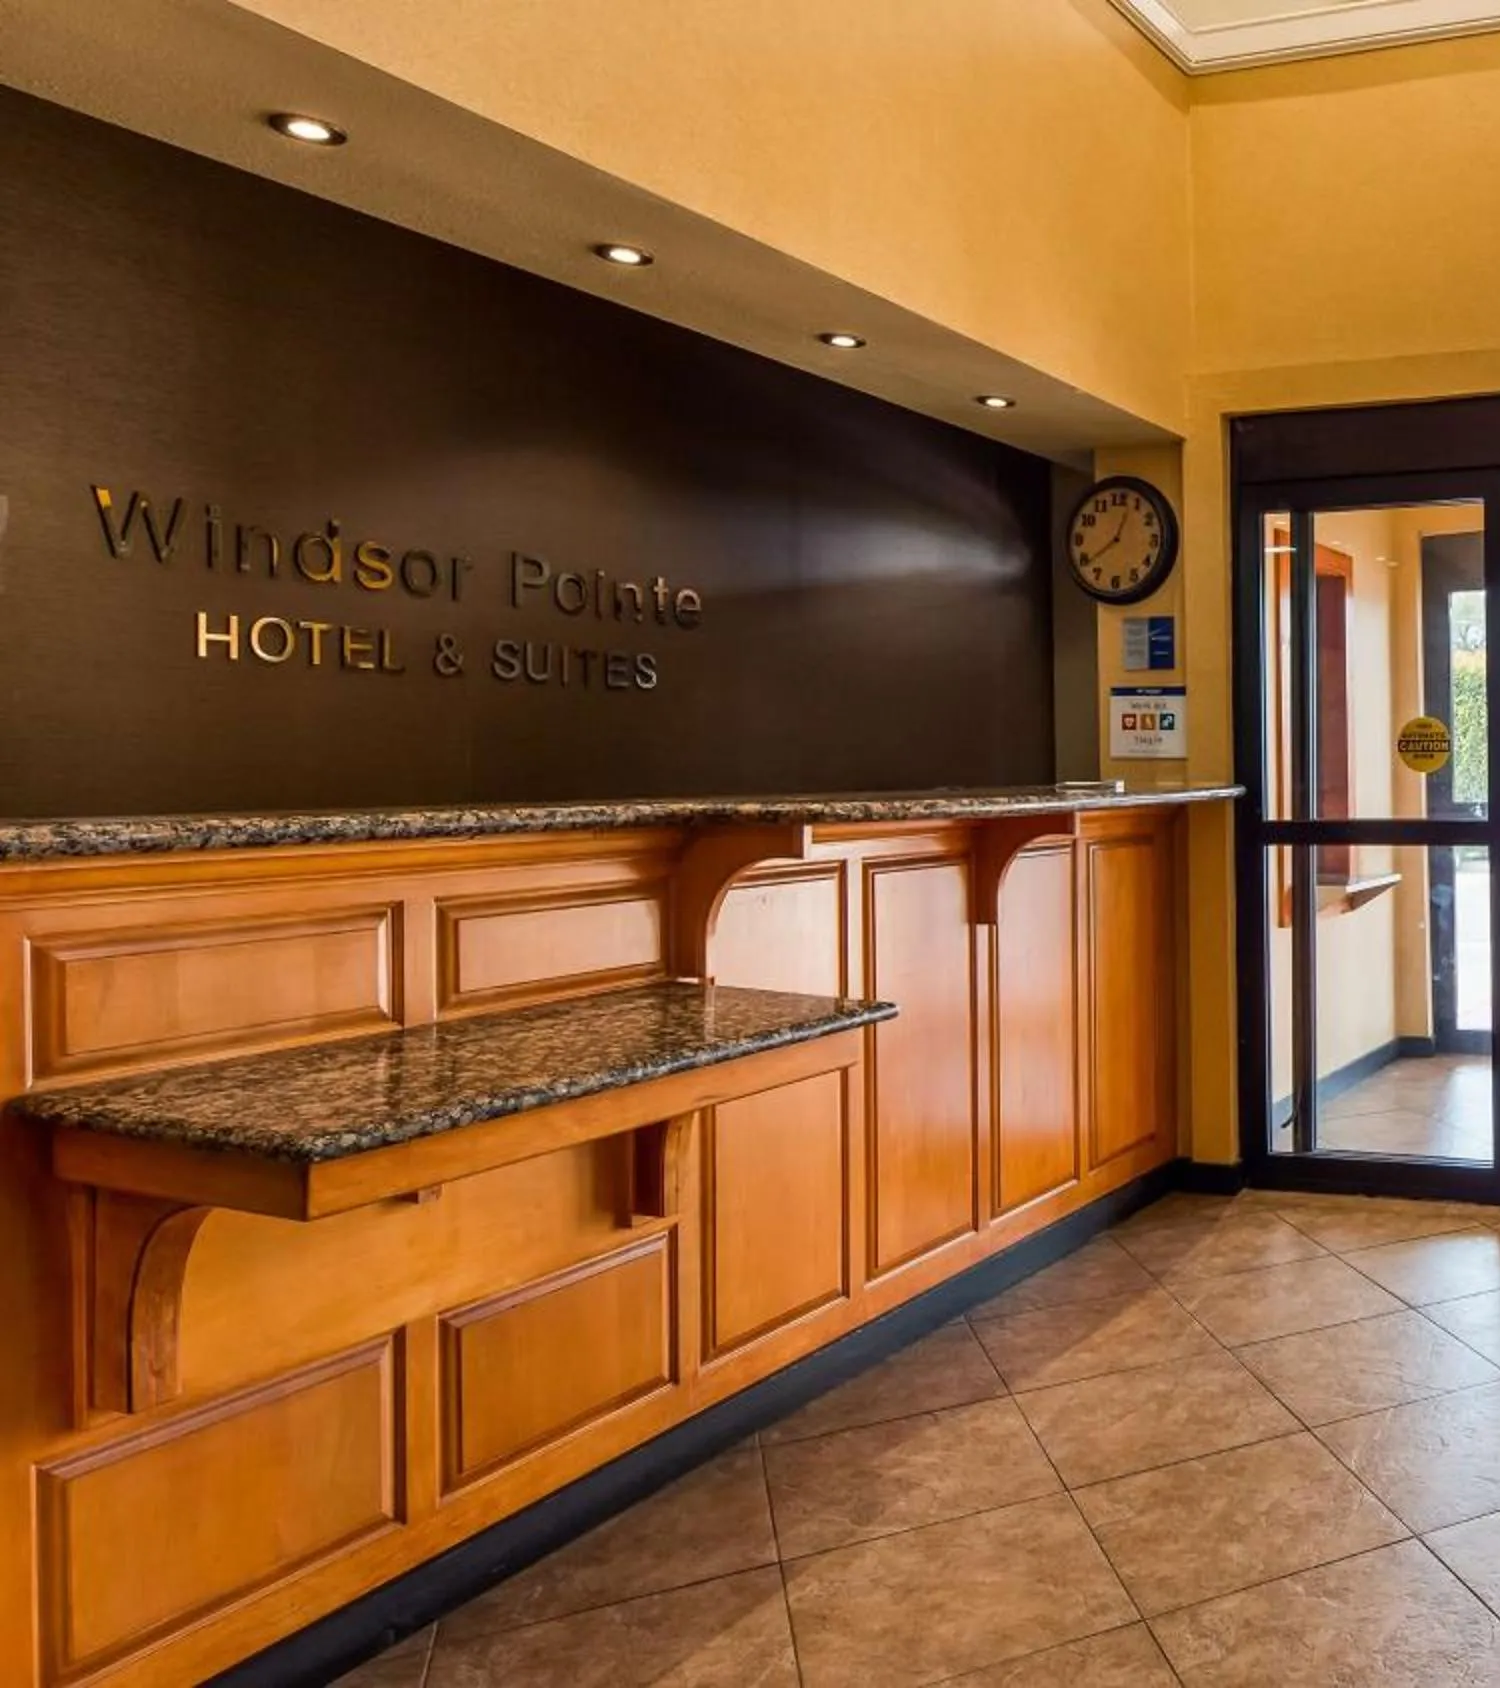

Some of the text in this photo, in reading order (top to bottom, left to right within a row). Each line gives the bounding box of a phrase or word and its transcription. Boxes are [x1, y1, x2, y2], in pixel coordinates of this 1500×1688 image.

[1094, 499, 1107, 513] 11
[1110, 492, 1128, 507] 12
[1081, 513, 1097, 528] 10
[1144, 511, 1154, 527] 2
[1149, 533, 1159, 549] 3
[90, 483, 702, 629] Windsor Pointe
[1142, 554, 1152, 569] 4
[1092, 567, 1102, 581] 7
[1129, 567, 1139, 582] 5
[1111, 575, 1121, 590] 6
[195, 611, 658, 690] HOTEL & SUITES
[1399, 741, 1449, 751] CAUTION
